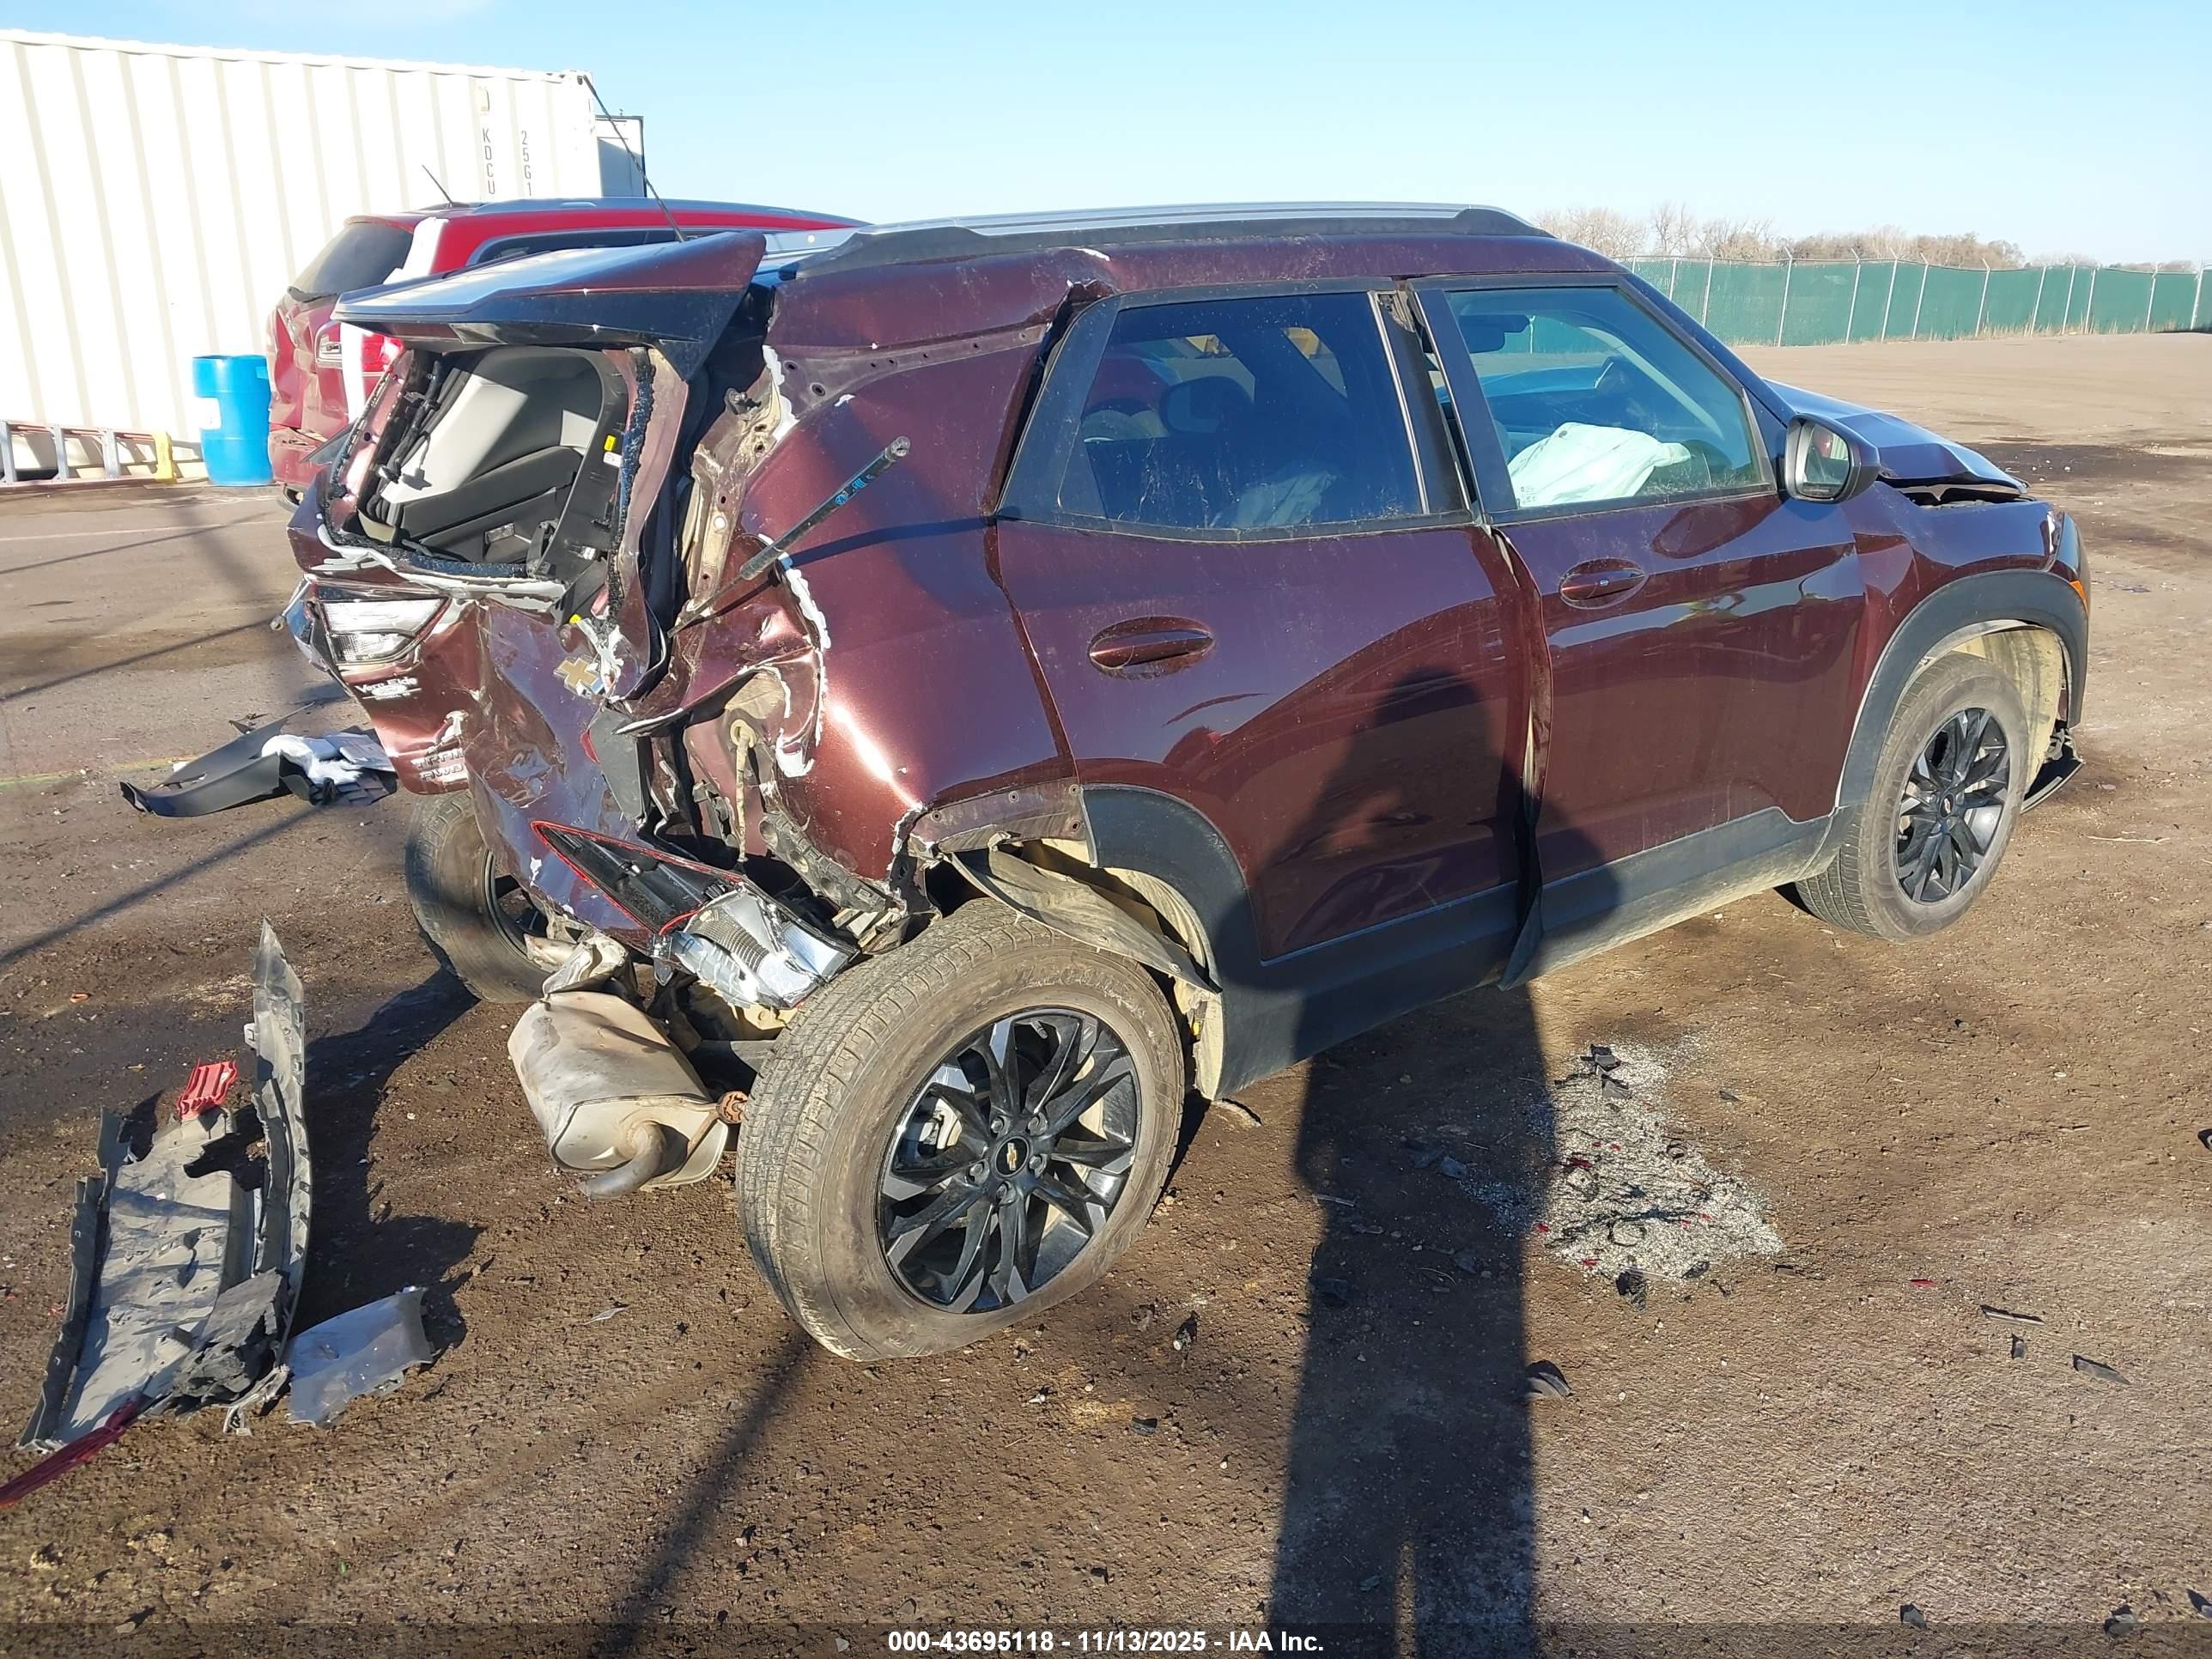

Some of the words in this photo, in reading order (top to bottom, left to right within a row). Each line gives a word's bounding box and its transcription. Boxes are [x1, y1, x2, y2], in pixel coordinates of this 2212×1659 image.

[482, 127, 495, 195] KDCU
[520, 130, 532, 197] 25G1
[419, 763, 464, 781] AWD
